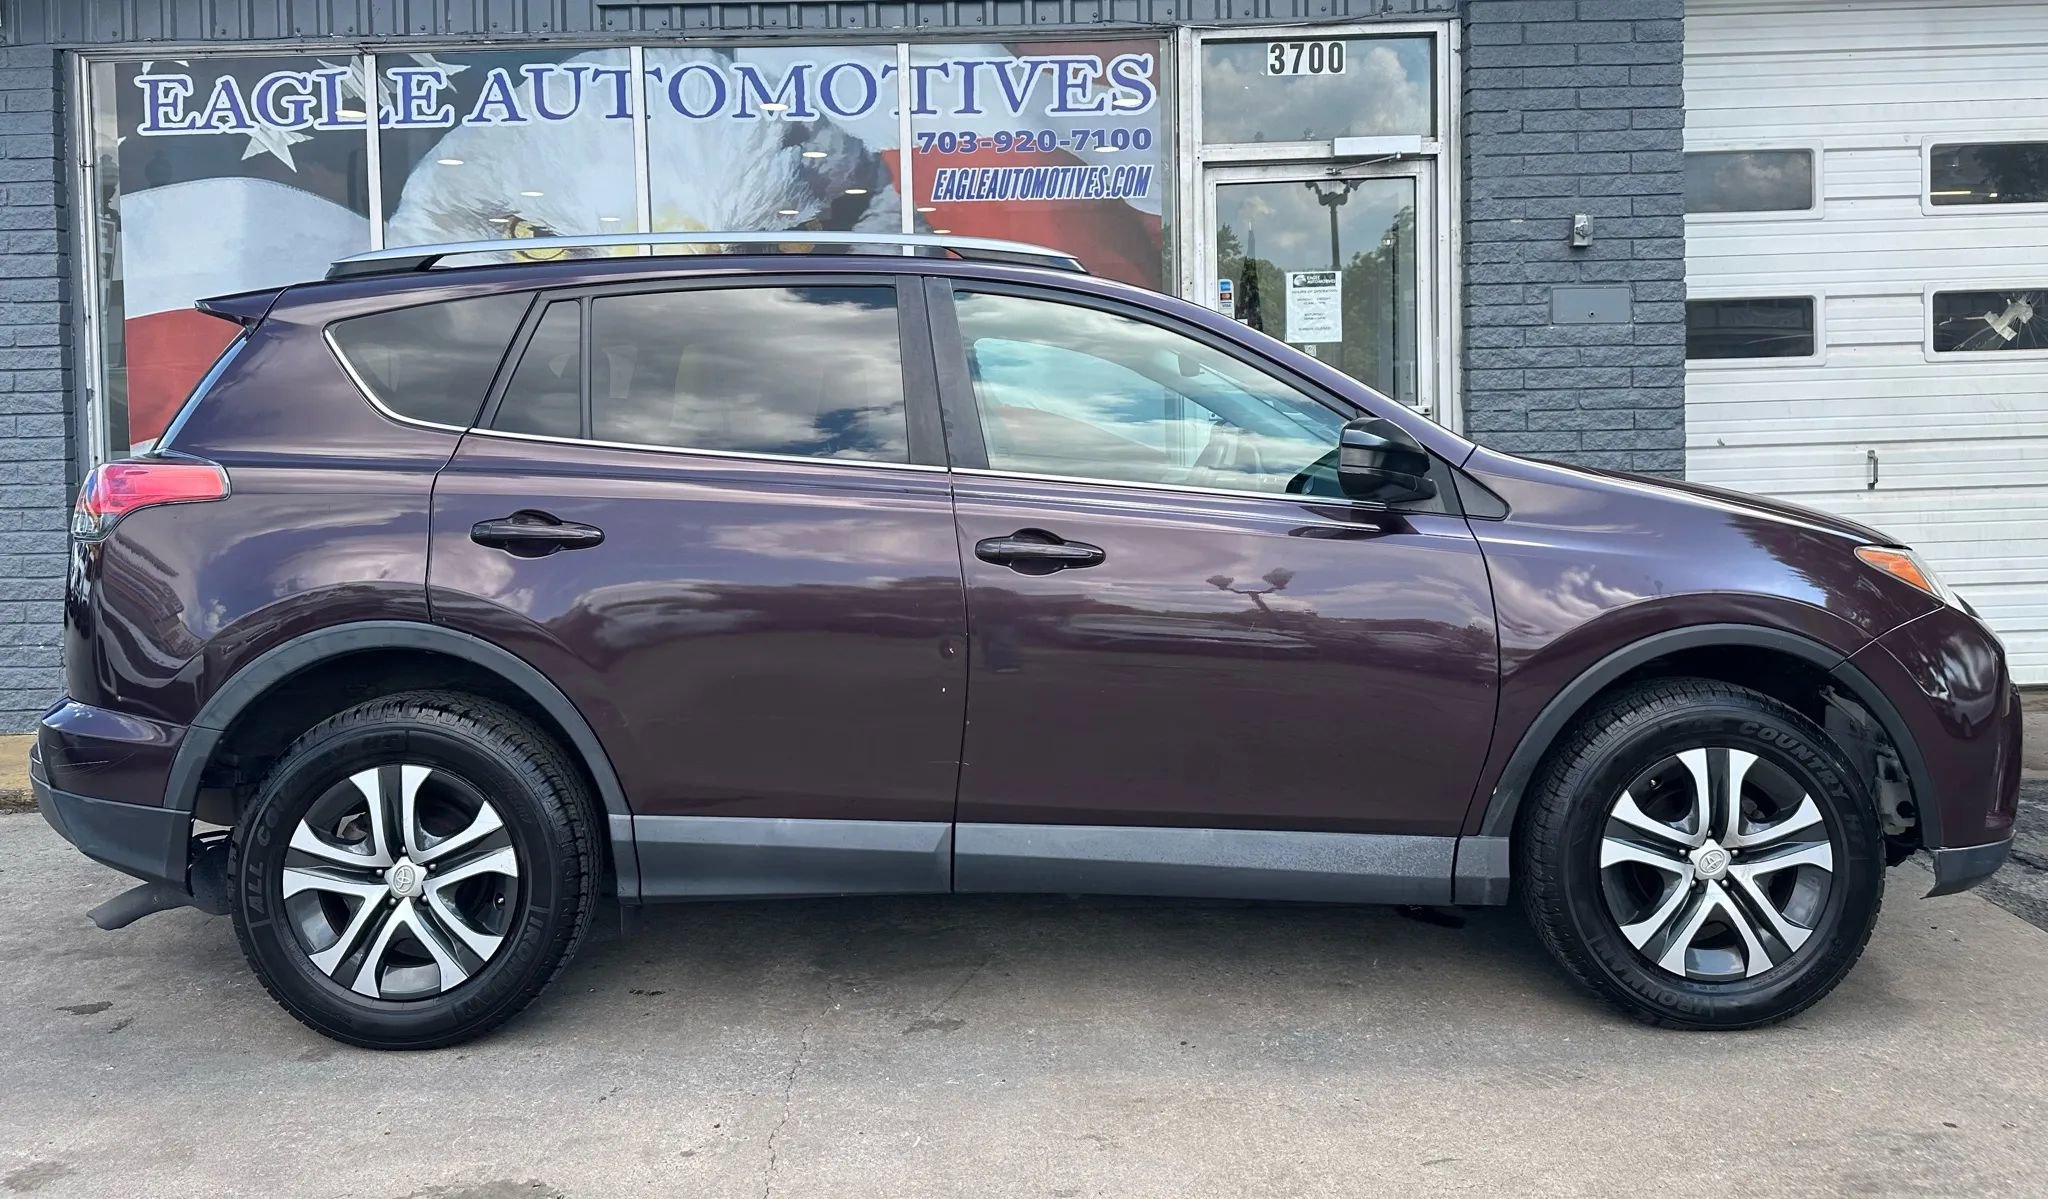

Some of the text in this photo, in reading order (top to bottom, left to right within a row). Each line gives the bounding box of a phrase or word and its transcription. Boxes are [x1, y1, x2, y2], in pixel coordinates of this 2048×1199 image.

[1269, 42, 1345, 75] 3700
[135, 53, 1157, 135] EAGLE AUTOMOTIVES
[917, 128, 1153, 154] 703-920-7100
[931, 164, 1154, 202] EAGLEAUTOMOTIVES.COM
[1739, 721, 1850, 800] COUNTRY
[247, 862, 265, 914] ALL
